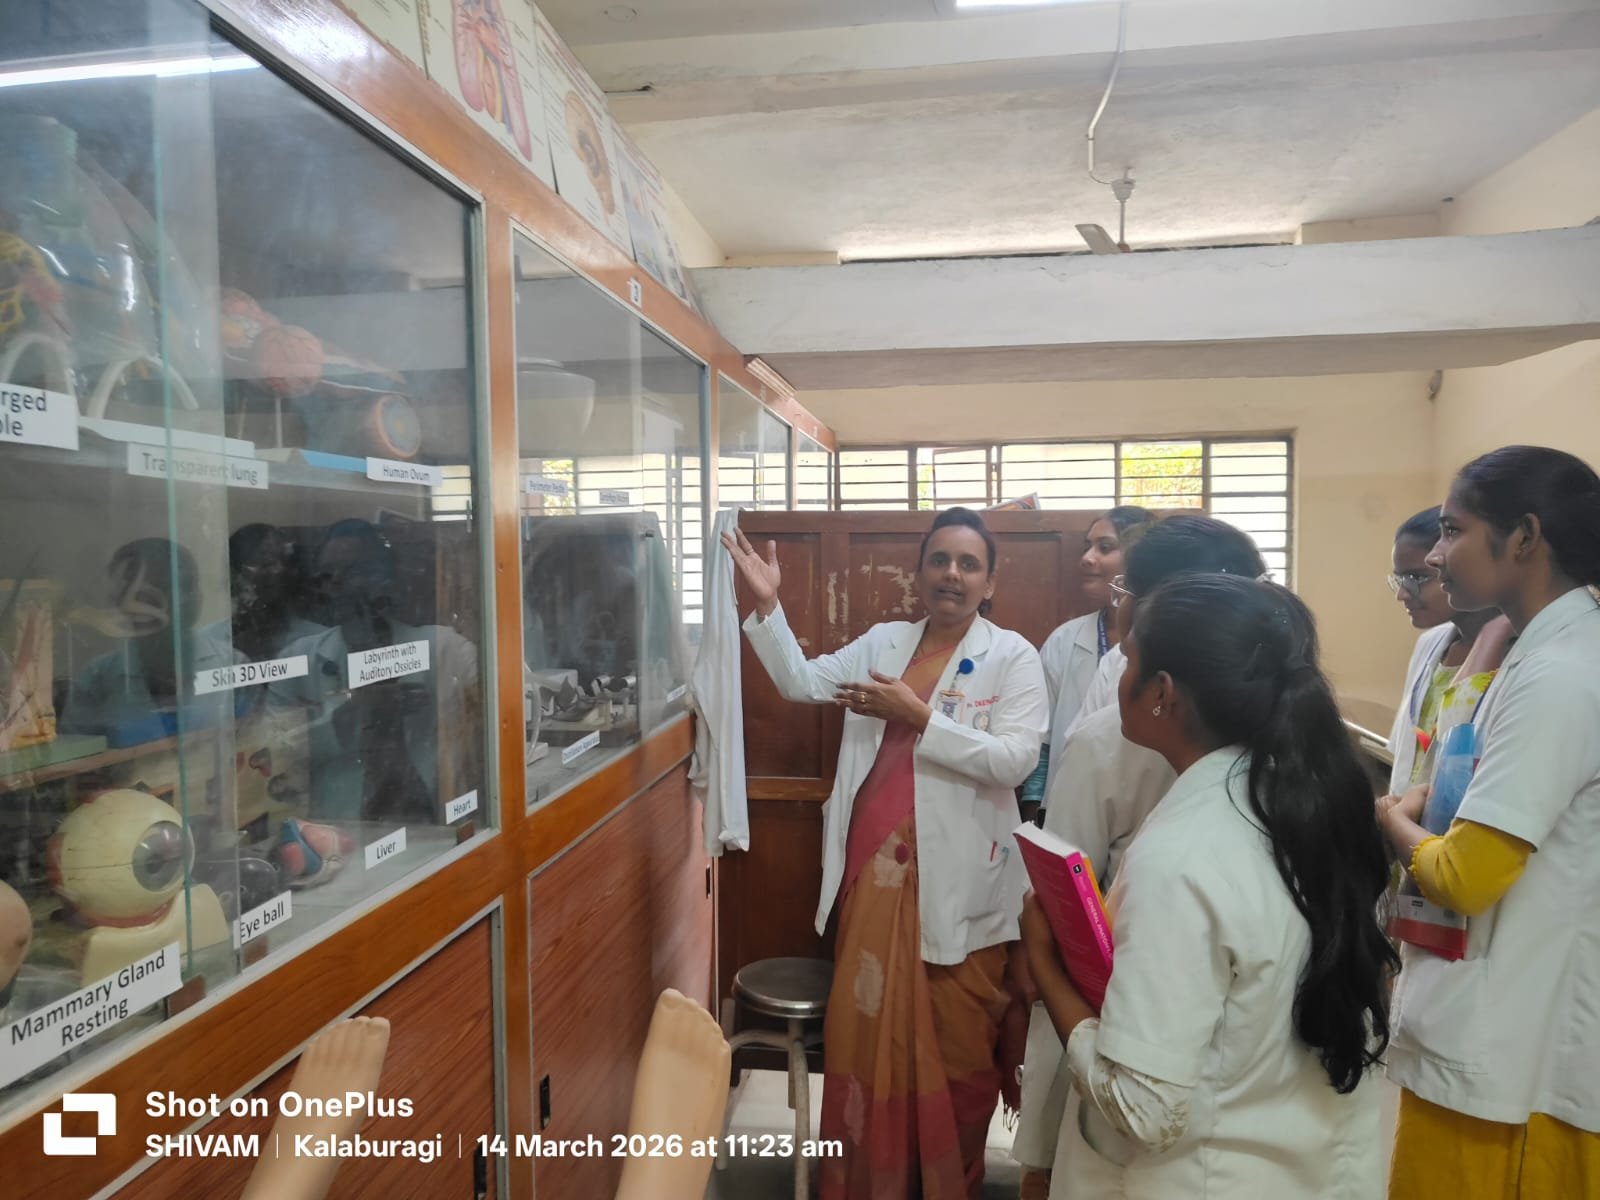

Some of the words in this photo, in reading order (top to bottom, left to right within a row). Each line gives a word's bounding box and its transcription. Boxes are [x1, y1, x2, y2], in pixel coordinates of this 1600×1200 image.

[0, 414, 24, 437] le
[231, 463, 259, 486] lung
[364, 647, 400, 665] Labyrinth
[401, 642, 417, 657] with
[240, 665, 256, 682] 3D
[260, 661, 288, 678] View
[360, 666, 393, 681] Auditory
[394, 657, 422, 674] Ossicles
[453, 799, 471, 817] Heart
[376, 841, 396, 860] Liver
[263, 900, 284, 926] ball
[11, 980, 112, 1046] Mammary
[117, 949, 166, 989] Gland
[61, 998, 129, 1047] Resting
